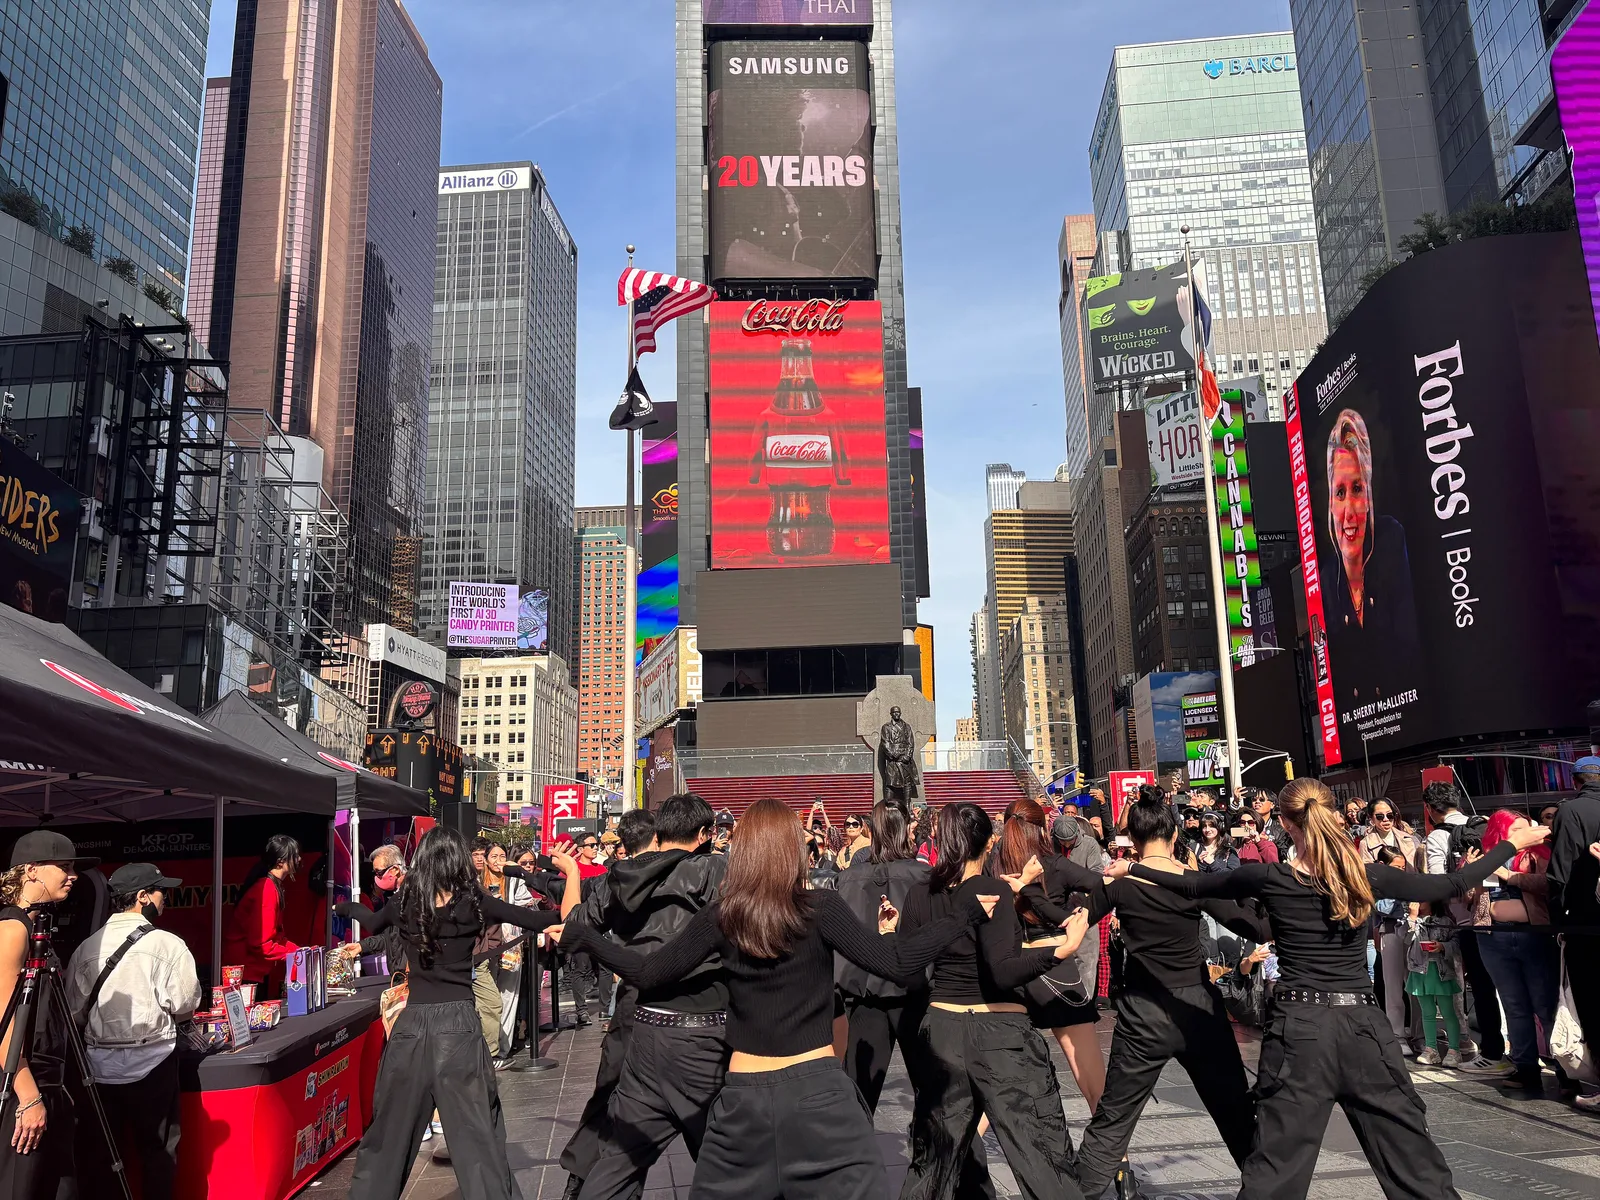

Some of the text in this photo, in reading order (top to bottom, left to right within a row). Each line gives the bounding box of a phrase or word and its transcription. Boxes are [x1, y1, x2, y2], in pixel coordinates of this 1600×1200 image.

[807, 0, 857, 14] THAI
[728, 57, 849, 75] SAMSUNG
[1229, 54, 1296, 75] BARCL
[441, 175, 494, 190] Allianz
[1101, 325, 1172, 344] Brains. Heart.
[1113, 337, 1160, 351] Courage.
[1315, 352, 1357, 404] Forbes Books
[769, 440, 829, 461] Coca-Cola
[1291, 430, 1305, 481] FREE
[1413, 338, 1480, 628] Forbes Books
[0, 475, 60, 554] IDERS
[1222, 432, 1254, 629] CANNABIS
[1258, 533, 1286, 541] KEVANI
[1296, 480, 1319, 597] CHOCOLATE
[12, 531, 40, 555] MUSICAL
[451, 585, 506, 598] INTRODUCING
[451, 596, 506, 609] THE WORLD'S
[450, 607, 497, 620] FIRST AI 3D
[449, 619, 515, 632] CANDY PRINTER
[448, 635, 517, 646] @THESUGARPRINTER
[396, 643, 443, 670] HYATT REGENCY
[410, 684, 424, 694] HOT
[1184, 706, 1214, 717] LICENSED
[1342, 688, 1419, 724] DR. SHERRY McALLISTER
[72, 840, 112, 850] ONGSHIM
